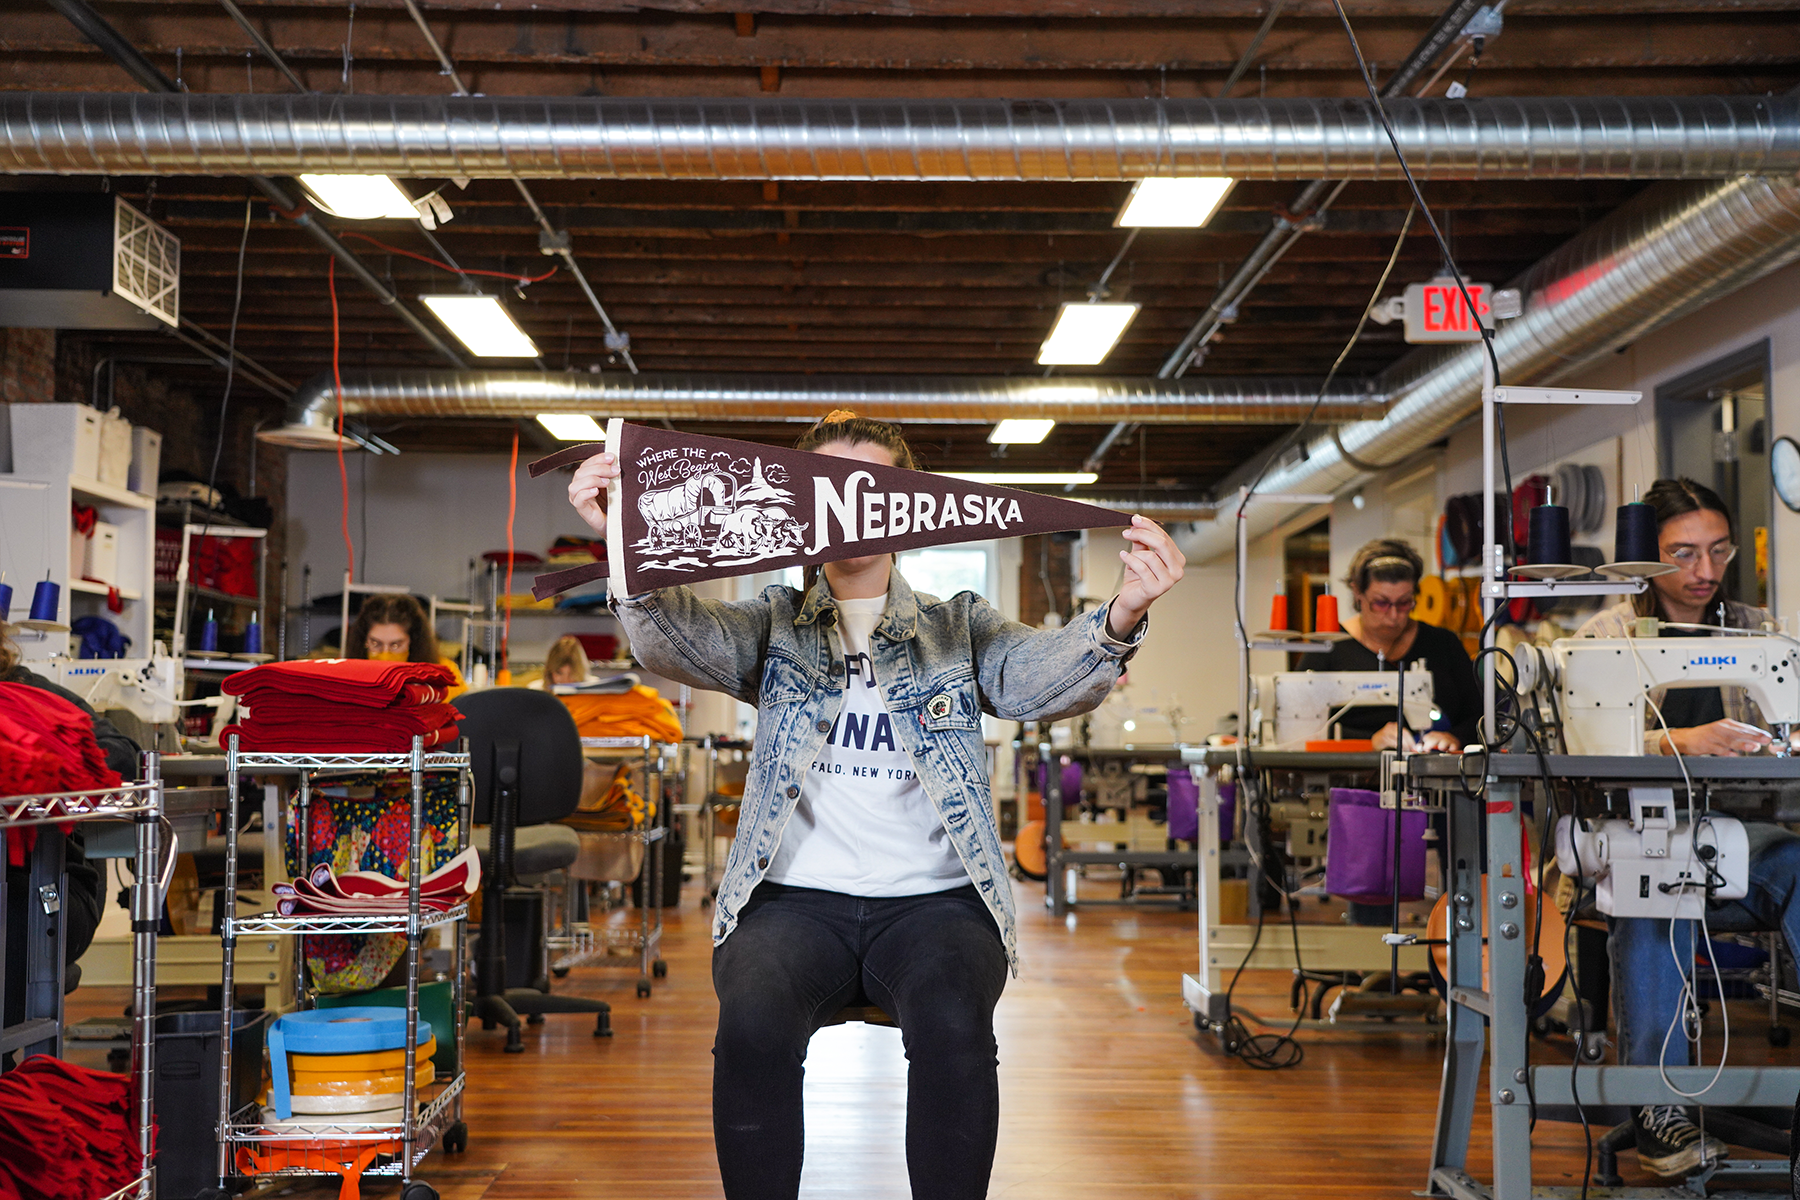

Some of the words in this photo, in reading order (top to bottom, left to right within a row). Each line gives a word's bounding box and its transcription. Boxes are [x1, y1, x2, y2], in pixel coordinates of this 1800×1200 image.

[1423, 286, 1484, 332] EXIT
[636, 448, 679, 468] WHERE
[682, 447, 707, 459] THE
[637, 464, 679, 490] West
[672, 458, 723, 480] Begins
[804, 470, 1024, 556] NEBRASKA
[1690, 656, 1736, 665] JUKI
[852, 766, 879, 778] NEW
